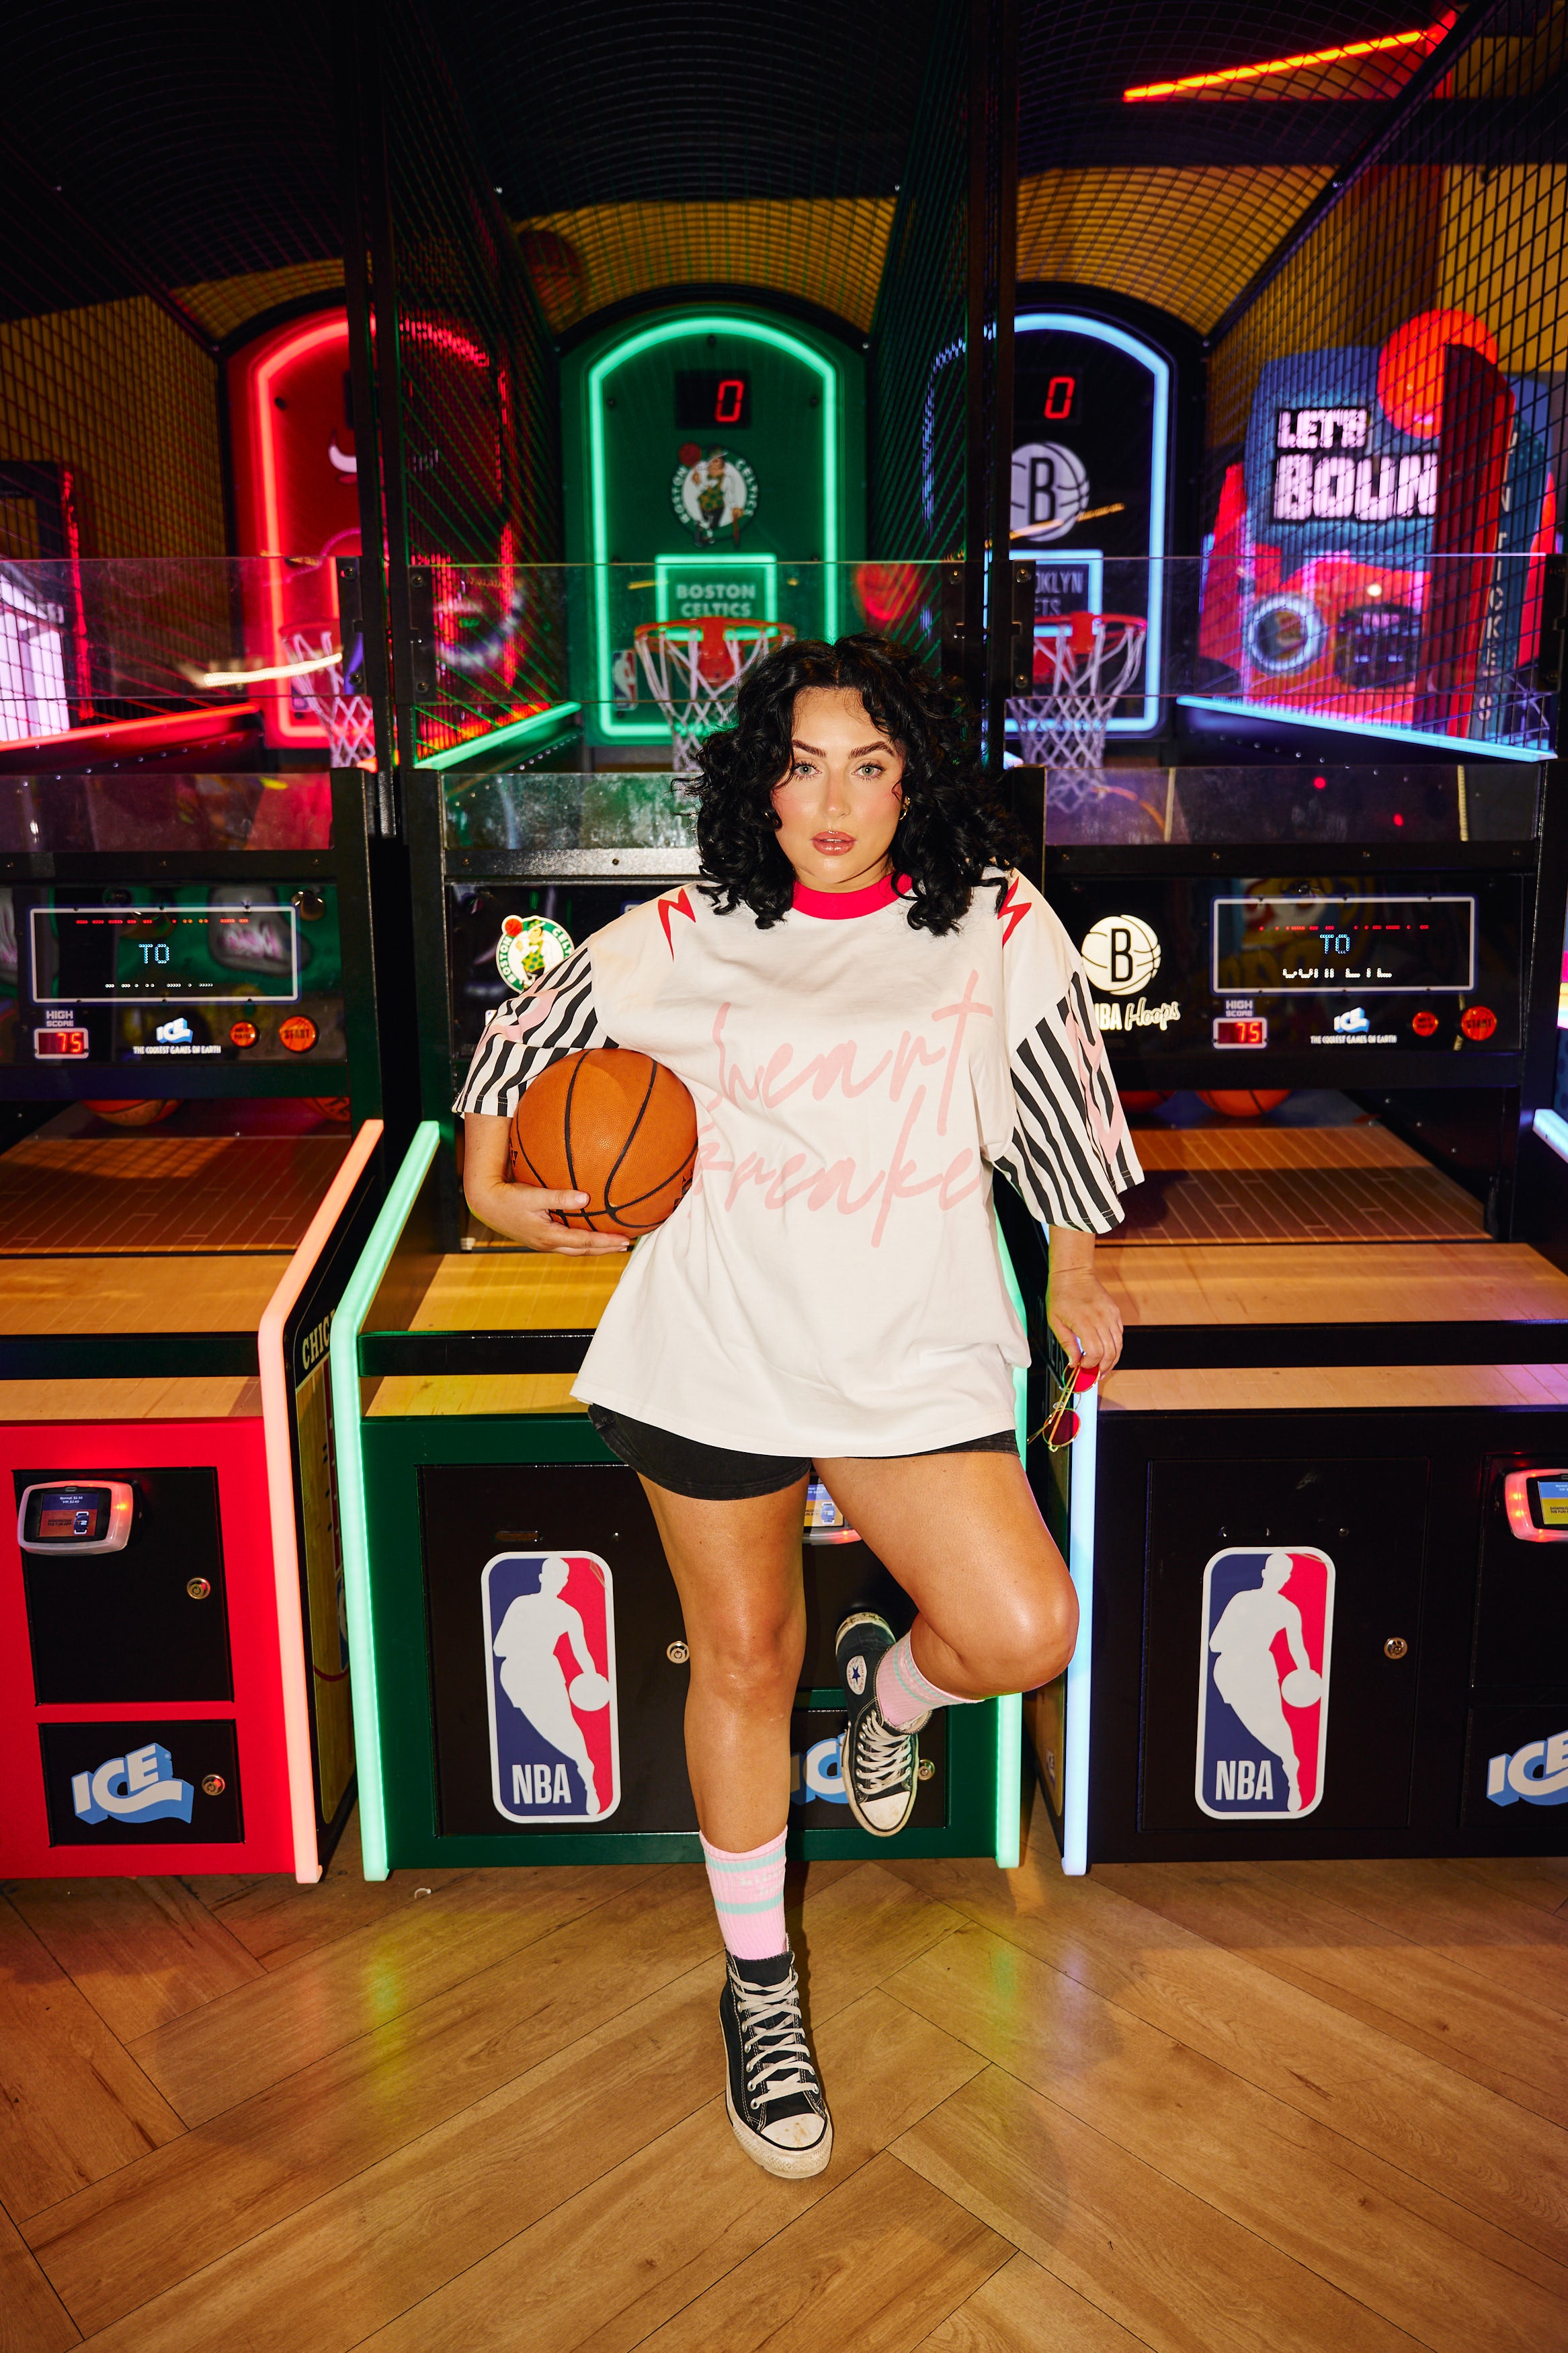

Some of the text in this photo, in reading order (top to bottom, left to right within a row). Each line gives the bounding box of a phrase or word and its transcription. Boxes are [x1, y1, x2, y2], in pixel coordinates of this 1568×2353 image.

[714, 380, 745, 422] 0
[1044, 376, 1075, 419] 0
[672, 464, 691, 524] BOSTON
[735, 458, 759, 518] CELTICS
[1029, 457, 1056, 526] B
[676, 584, 755, 599] BOSTON
[681, 602, 751, 618] CELTICS
[138, 943, 170, 964] TO
[1111, 928, 1133, 982] B
[1320, 934, 1350, 955] TO
[499, 935, 518, 983] BOSTON
[46, 1010, 73, 1019] HIGH
[1124, 996, 1181, 1031] Hoops
[1226, 1000, 1252, 1009] HIGH
[156, 1017, 193, 1043] ICE
[1236, 1022, 1260, 1043] 75
[1333, 1007, 1370, 1033] ICE
[1466, 1019, 1491, 1029] START
[56, 1033, 83, 1053] 75
[284, 1029, 310, 1039] START
[1311, 1035, 1397, 1044] THE COOLEST GAMES ON EARTH
[133, 1045, 221, 1054] THE COOLEST GAMES ON EARTH
[712, 968, 993, 1136] heart
[302, 1309, 335, 1369] CHIC
[71, 1743, 192, 1824] ICE
[511, 1763, 571, 1804] NBA
[1215, 1759, 1274, 1800] NBA
